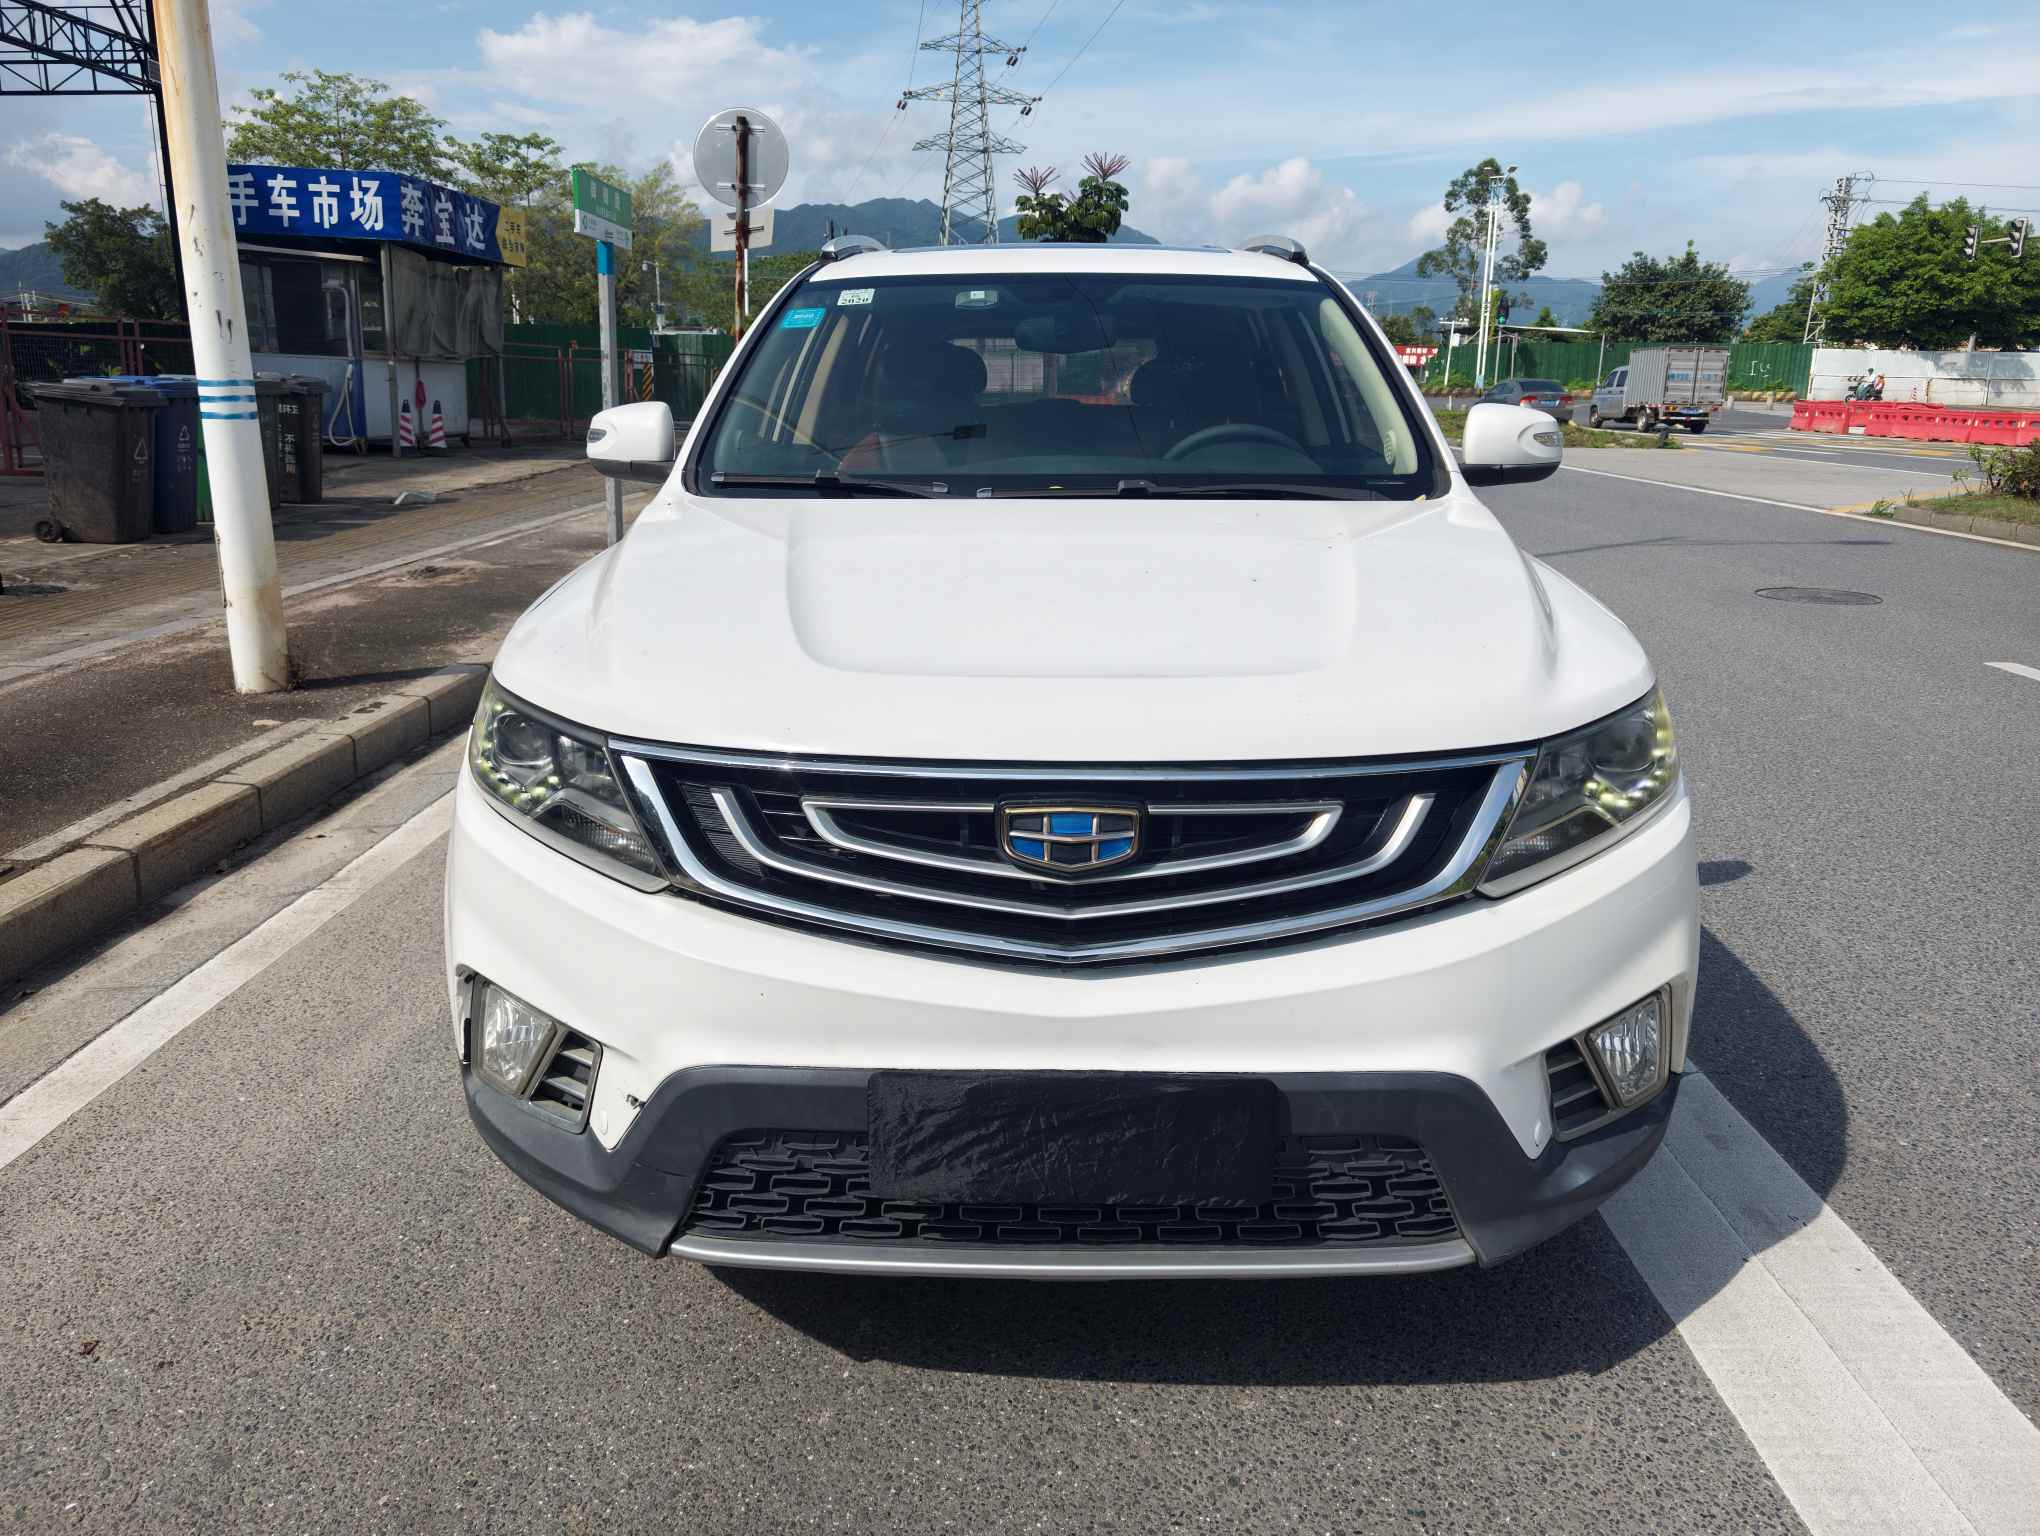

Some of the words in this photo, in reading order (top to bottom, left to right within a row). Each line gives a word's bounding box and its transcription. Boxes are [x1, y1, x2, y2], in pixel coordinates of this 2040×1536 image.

[229, 172, 384, 231] 手车市场
[400, 182, 486, 250] 奔宝达
